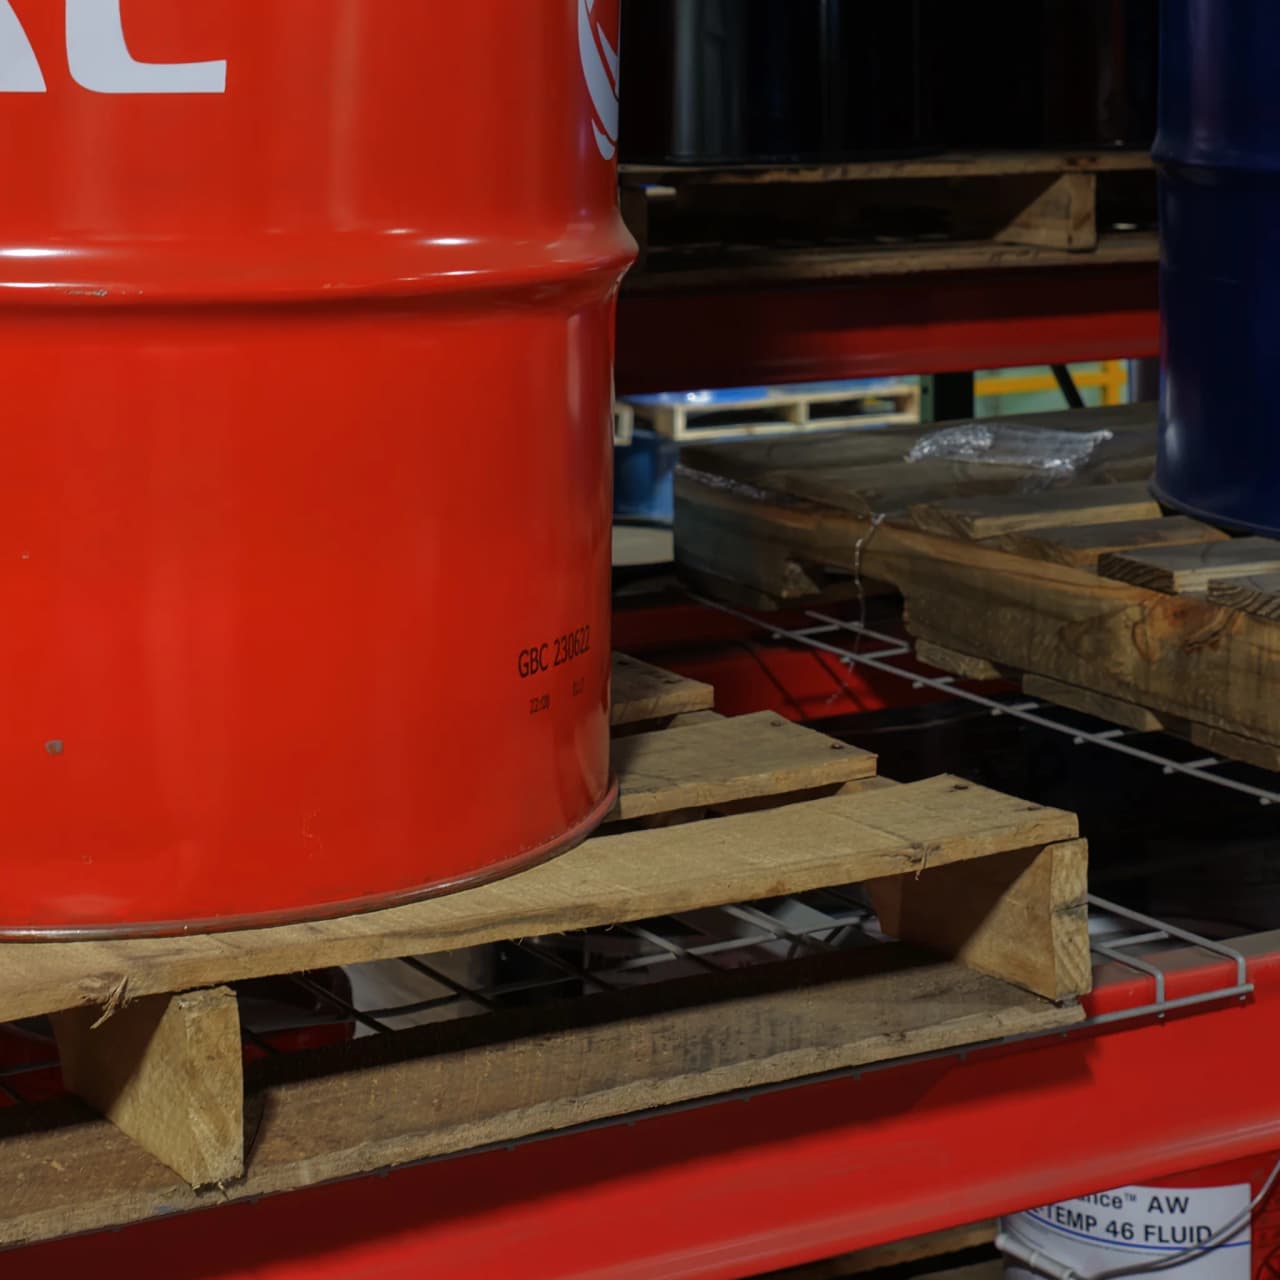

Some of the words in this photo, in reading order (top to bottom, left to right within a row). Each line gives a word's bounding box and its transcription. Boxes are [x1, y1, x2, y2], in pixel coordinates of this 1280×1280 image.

[518, 642, 549, 678] GBC
[1148, 1196, 1190, 1214] AW
[1106, 1221, 1134, 1240] 46
[1144, 1225, 1213, 1244] FLUID
